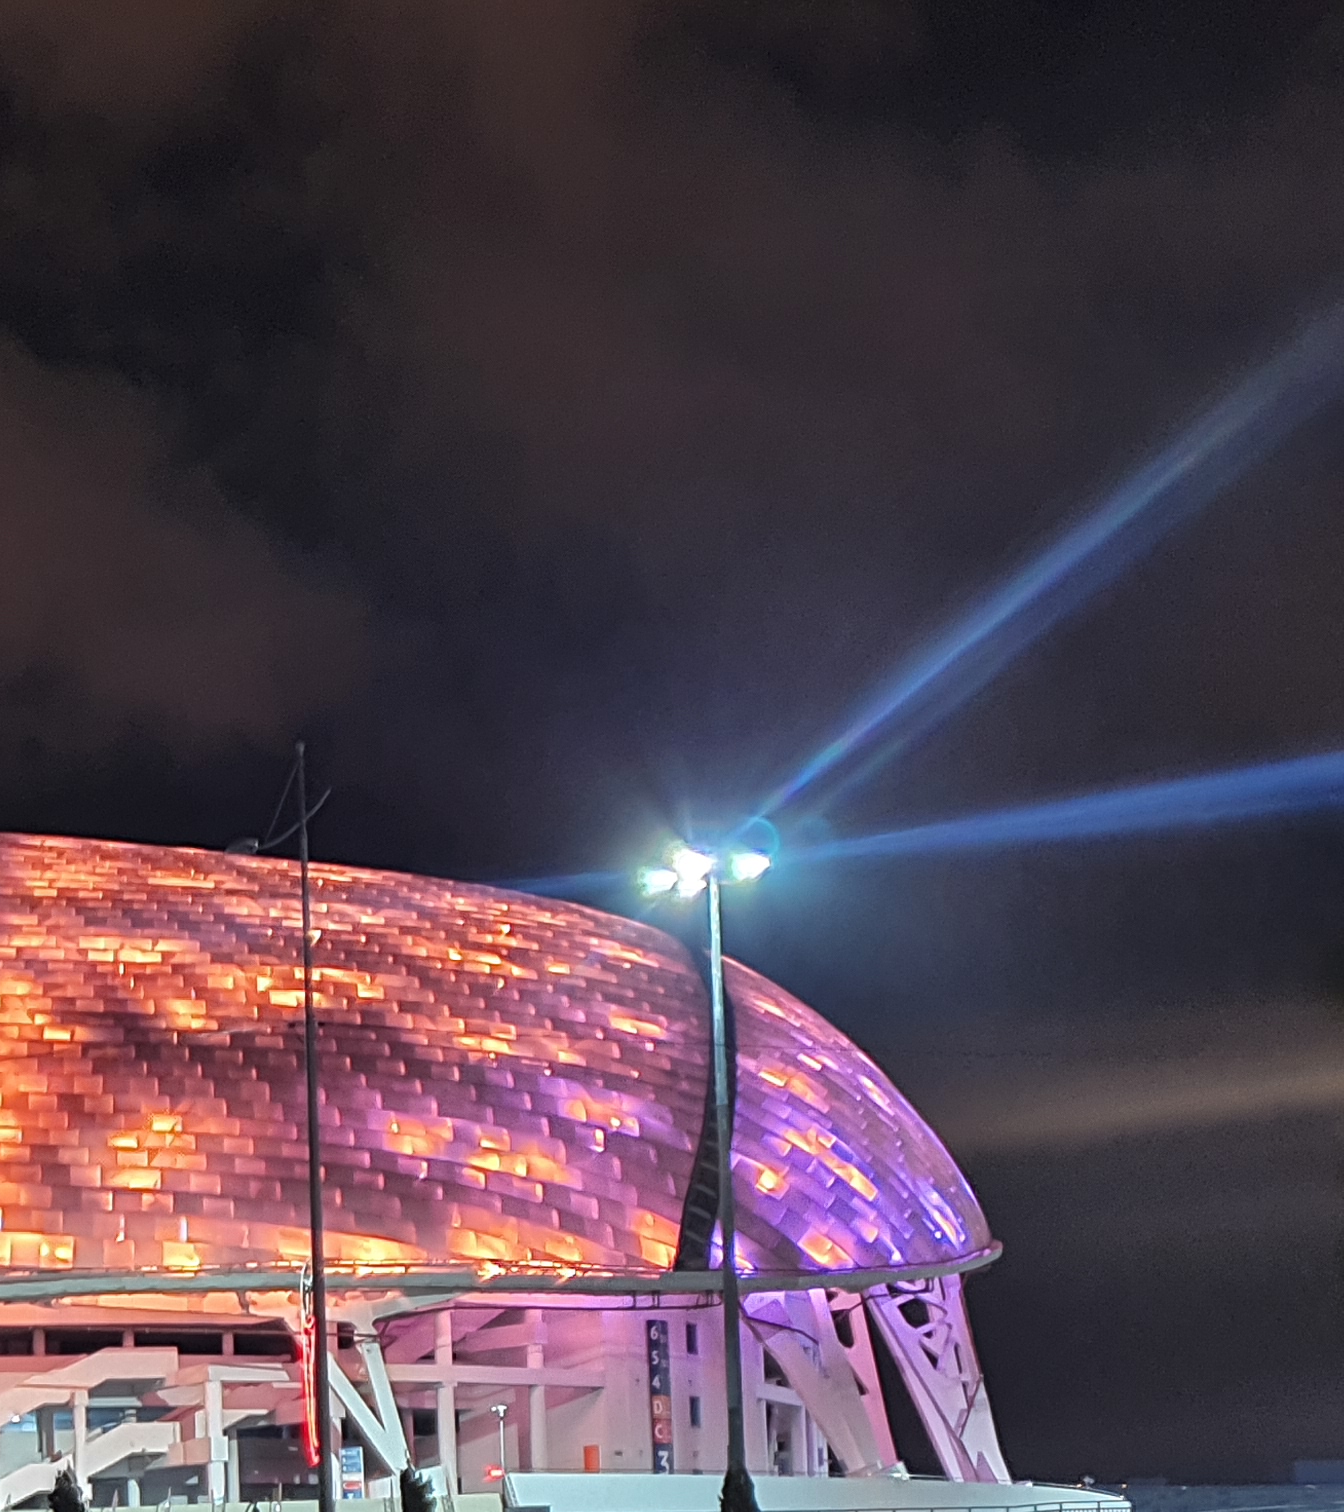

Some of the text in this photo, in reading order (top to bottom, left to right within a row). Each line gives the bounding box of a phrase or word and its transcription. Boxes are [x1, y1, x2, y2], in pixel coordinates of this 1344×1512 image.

[650, 1326, 659, 1340] 6
[652, 1350, 659, 1365] 5
[652, 1374, 661, 1390] 4
[653, 1400, 663, 1415] D
[658, 1450, 670, 1475] 3
